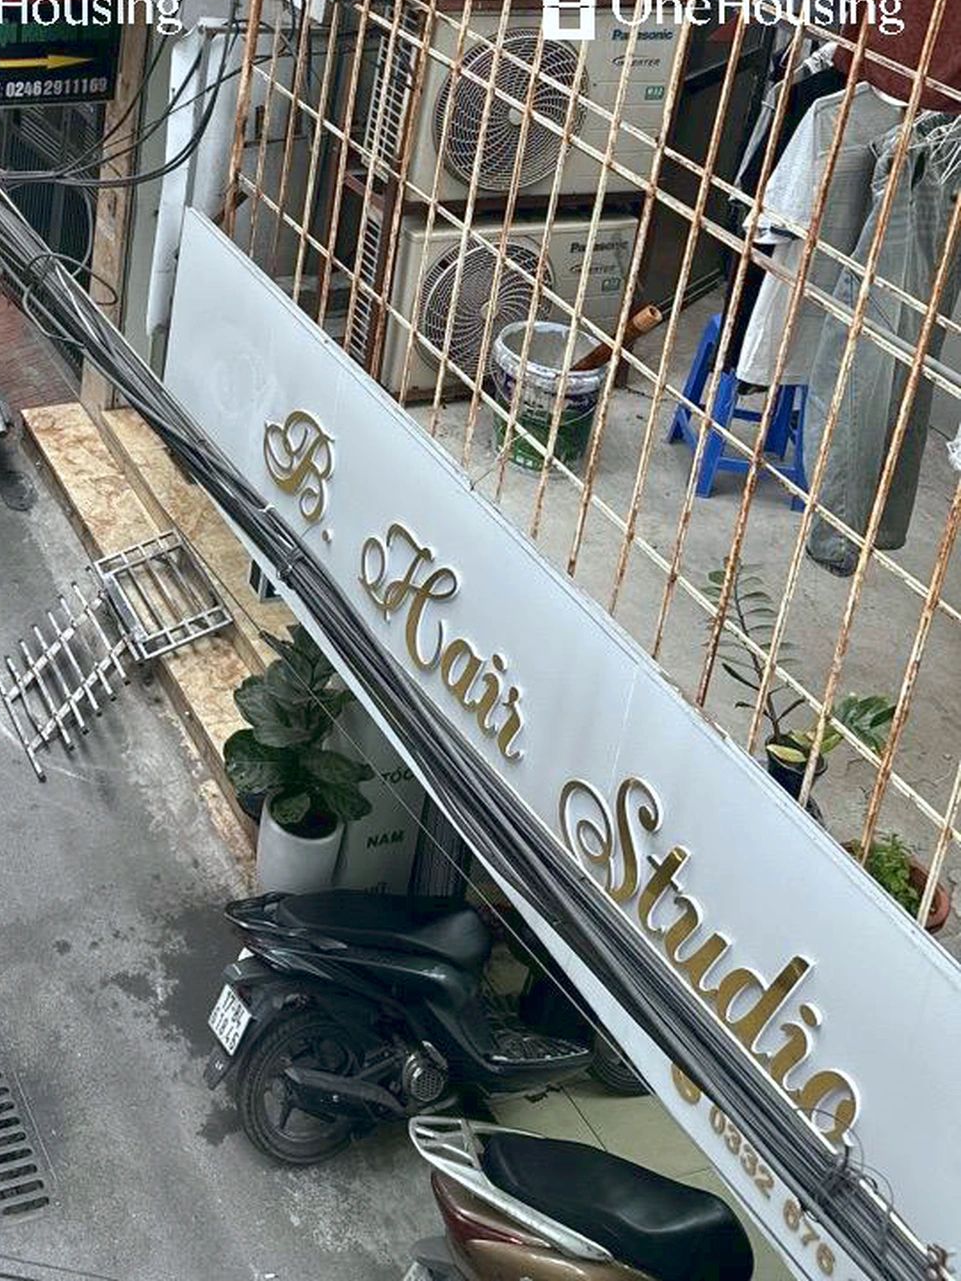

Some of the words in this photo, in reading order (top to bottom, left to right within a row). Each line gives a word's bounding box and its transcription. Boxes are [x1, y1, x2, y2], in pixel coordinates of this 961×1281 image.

[357, 522, 525, 763] Hair
[558, 776, 861, 1148] Studio
[366, 830, 404, 849] NAM
